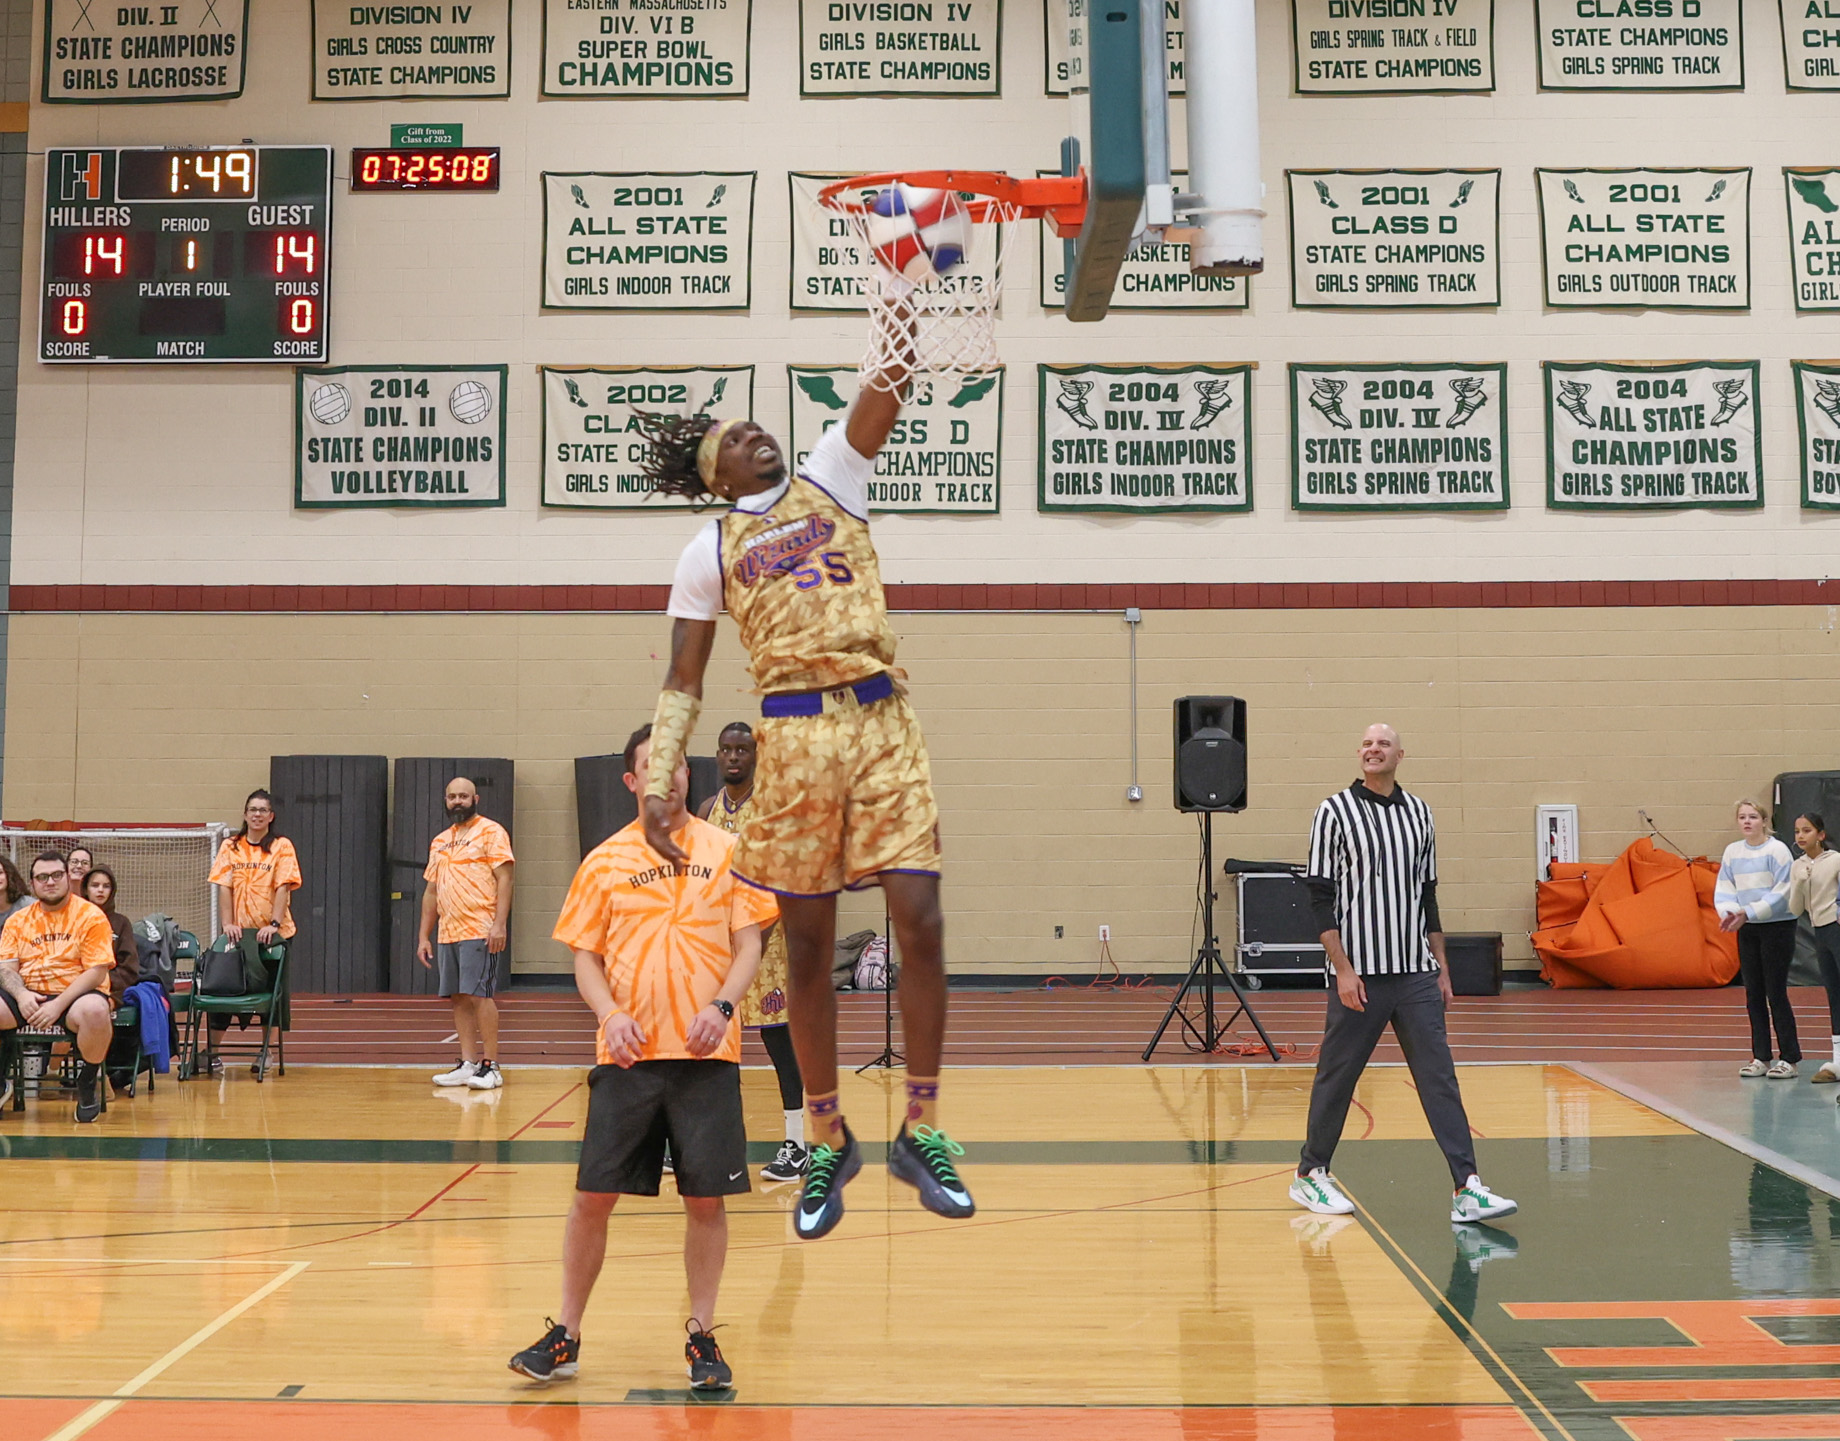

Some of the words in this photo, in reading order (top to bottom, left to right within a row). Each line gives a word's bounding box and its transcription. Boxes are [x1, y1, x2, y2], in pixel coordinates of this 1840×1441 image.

[118, 8, 153, 25] DIV.
[160, 6, 178, 25] II
[351, 6, 441, 25] DIVISION
[453, 6, 471, 23] IV
[829, 3, 932, 21] DIVISION
[948, 4, 971, 21] IV
[1329, 0, 1424, 18] DIVISION
[1433, 0, 1457, 16] IV
[1577, 0, 1672, 17] CLASS
[1683, 0, 1700, 17] D
[601, 16, 638, 34] DIV.
[650, 16, 672, 34] VI
[681, 16, 693, 34] B
[328, 38, 367, 56] GIRLS
[376, 37, 422, 54] CROSS
[431, 36, 495, 53] COUNTRY
[820, 33, 864, 50] GIRLS
[876, 32, 980, 51] BASKETBALL
[1311, 31, 1340, 49] GIRLS
[1347, 30, 1384, 48] SPRING
[1392, 29, 1428, 47] TRACK
[1435, 35, 1441, 46] &
[1447, 28, 1476, 46] FIELD
[1552, 28, 1611, 46] STATE
[1621, 28, 1728, 46] CHAMPIONS
[56, 38, 112, 60] STATE
[121, 34, 235, 59] CHAMPIONS
[579, 41, 647, 58] SUPER
[657, 41, 712, 59] BOWL
[559, 62, 733, 86] CHAMPIONS
[811, 62, 870, 80] STATE
[881, 61, 990, 80] CHAMPIONS
[1309, 60, 1367, 79] STATE
[1376, 59, 1481, 78] CHAMPIONS
[1563, 57, 1604, 74] GIRLS
[1612, 57, 1663, 74] SPRING
[1672, 57, 1720, 74] TRACK
[63, 69, 118, 89] GIRLS
[128, 66, 227, 88] LACROSSE
[328, 67, 382, 86] STATE
[391, 66, 495, 84] CHAMPIONS
[401, 136, 422, 144] Class
[423, 135, 432, 143] of
[434, 135, 452, 143] 2022
[407, 127, 424, 136] Gift
[425, 127, 445, 135] from
[171, 153, 250, 193] 1:49
[362, 155, 490, 183] 07:25:08
[614, 188, 683, 206] 2001
[1362, 187, 1429, 205] 2001
[1609, 184, 1680, 203] 2001
[50, 206, 131, 227] HILLERS
[248, 205, 314, 225] GUEST
[1568, 214, 1625, 232] ALL
[1637, 214, 1724, 233] STATE
[161, 218, 210, 232] PERIOD
[569, 217, 625, 235] ALL
[637, 216, 727, 234] STATE
[1332, 216, 1428, 234] CLASS
[1439, 216, 1457, 234] D
[85, 237, 122, 274] 14
[187, 240, 195, 270] 1
[276, 236, 314, 274] 14
[567, 245, 727, 264] CHAMPIONS
[1306, 245, 1366, 263] STATE
[1376, 245, 1484, 263] CHAMPIONS
[1565, 244, 1729, 263] CHAMPIONS
[47, 283, 91, 297] FOULS
[139, 282, 190, 296] PLAYER
[196, 282, 231, 296] FOUL
[275, 281, 319, 296] FOULS
[565, 277, 608, 295] GIRLS
[617, 277, 671, 295] INDOOR
[681, 276, 731, 293] TRACK
[1123, 274, 1235, 292] CHAMPIONS
[1316, 274, 1358, 292] GIRLS
[1366, 275, 1418, 292] SPRING
[1427, 274, 1476, 292] TRACK
[1558, 274, 1601, 292] GIRLS
[1610, 274, 1679, 292] OUTDOOR
[1687, 275, 1736, 293] TRACK
[64, 301, 84, 334] 0
[291, 299, 312, 333] 0
[46, 342, 90, 356] SCORE
[157, 341, 205, 355] MATCH
[274, 341, 318, 355] SCORE
[371, 379, 429, 398] 2014
[608, 385, 686, 404] 2002
[1109, 382, 1179, 402] 2004
[1364, 380, 1433, 400] 2004
[1617, 379, 1687, 399] 2004
[365, 407, 408, 427] DIV.
[420, 407, 435, 427] II
[1105, 410, 1149, 430] DIV.
[1157, 410, 1184, 430] IV
[1360, 408, 1404, 428] DIV.
[1412, 408, 1440, 428] IV
[1600, 406, 1636, 432] ALL
[1643, 404, 1705, 432] STATE
[950, 420, 969, 445] D
[308, 437, 363, 463] STATE
[373, 437, 492, 462] CHAMPIONS
[557, 443, 618, 463] STATE
[1052, 439, 1108, 464] STATE
[1116, 439, 1235, 465] CHAMPIONS
[1305, 438, 1361, 463] STATE
[1371, 437, 1491, 463] CHAMPIONS
[1572, 438, 1737, 465] CHAMPIONS
[874, 451, 994, 476] CHAMPIONS
[331, 470, 468, 493] VOLLEYBALL
[566, 474, 609, 493] GIRLS
[1054, 472, 1102, 495] GIRLS
[1111, 473, 1174, 497] INDOOR
[1182, 473, 1238, 495] TRACK
[1307, 472, 1357, 494] GIRLS
[1365, 472, 1429, 494] SPRING
[1437, 471, 1494, 493] TRACK
[1563, 473, 1612, 496] GIRLS
[1621, 473, 1684, 496] SPRING
[1692, 472, 1749, 495] TRACK
[935, 483, 993, 502] TRACK
[791, 552, 853, 590] 55
[629, 864, 712, 889] HOPKITON
